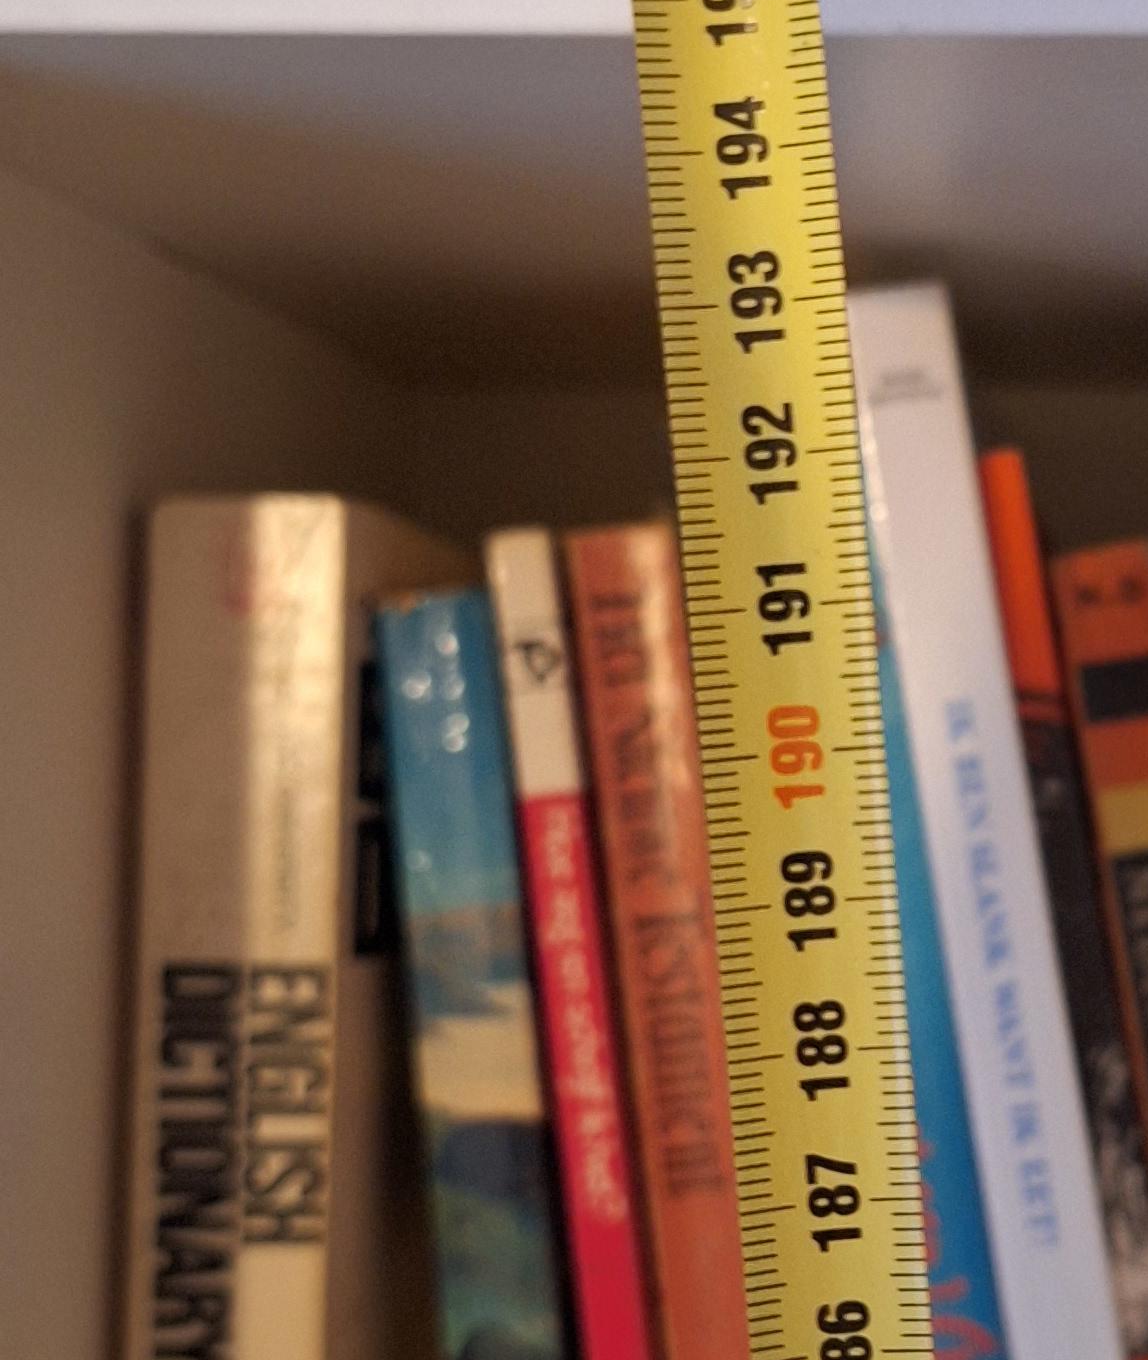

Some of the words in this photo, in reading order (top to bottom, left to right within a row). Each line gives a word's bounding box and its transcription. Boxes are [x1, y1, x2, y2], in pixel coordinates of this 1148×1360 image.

[712, 97, 771, 200] 194
[727, 251, 785, 354] 193
[741, 403, 798, 505] 192
[755, 563, 812, 656] 191
[768, 707, 823, 808] 190
[780, 851, 837, 952] 189
[792, 1000, 850, 1101] 188
[247, 963, 326, 1248] ENGLISH
[805, 1154, 862, 1253] 187
